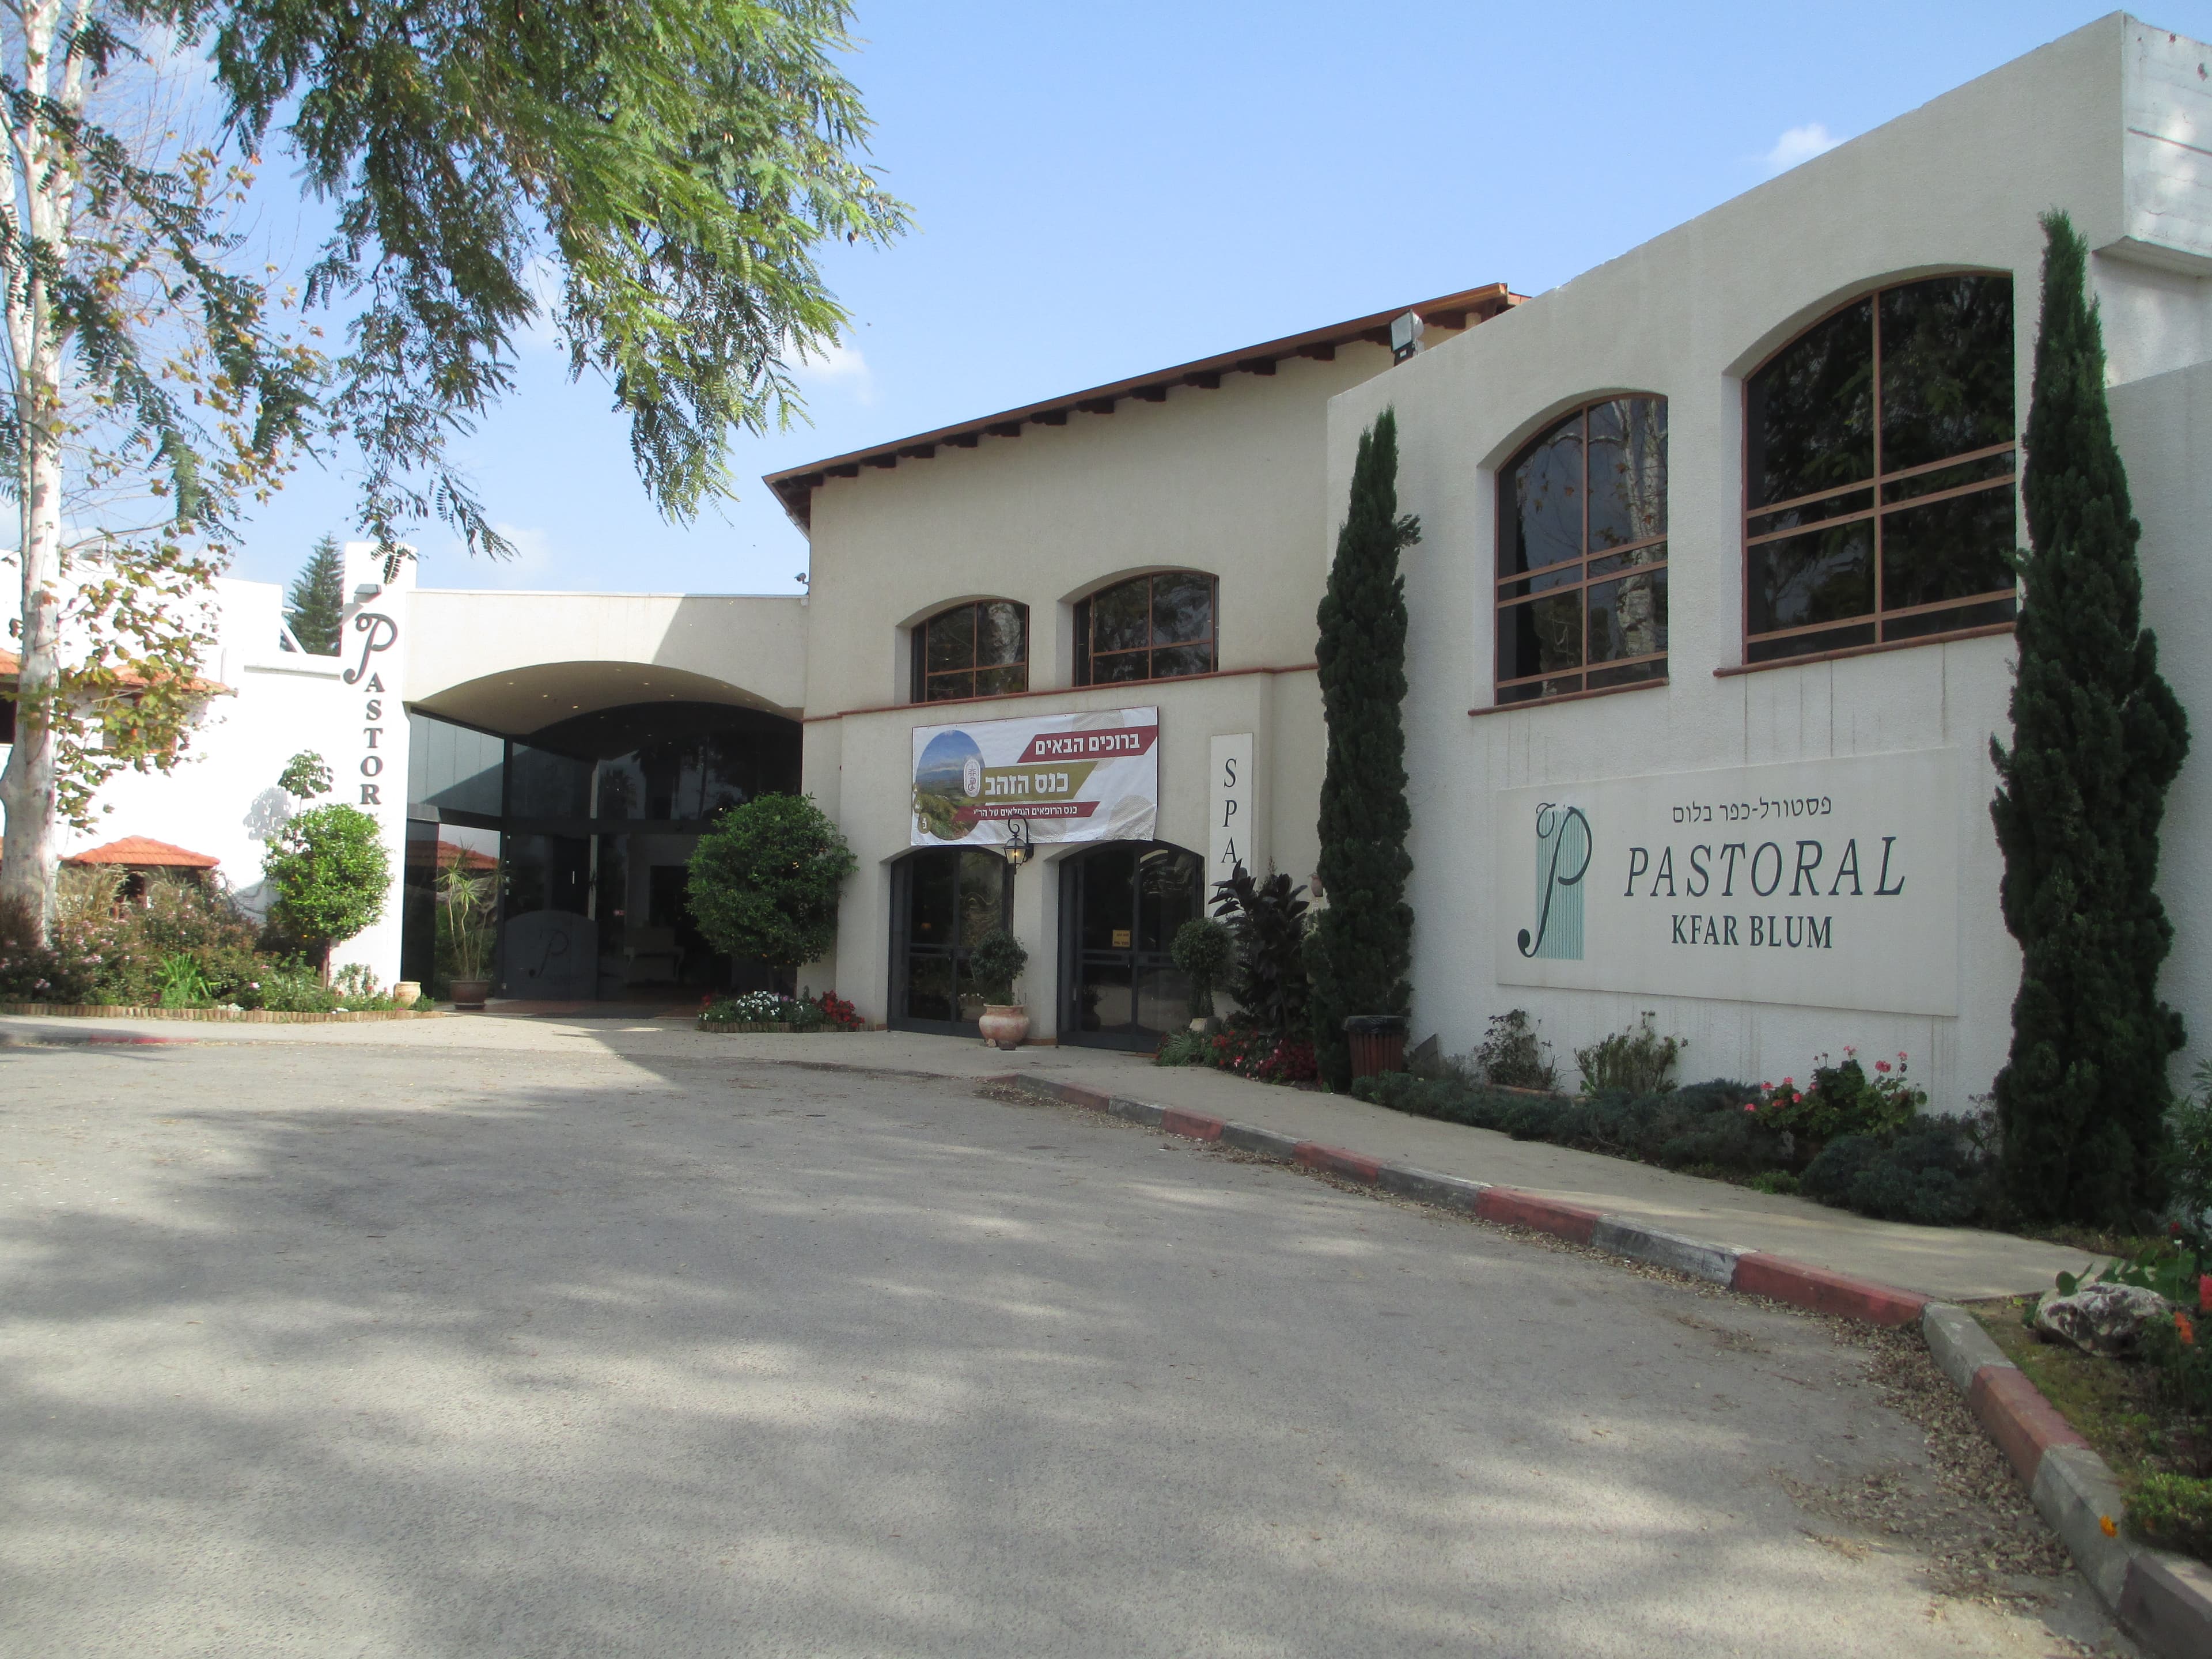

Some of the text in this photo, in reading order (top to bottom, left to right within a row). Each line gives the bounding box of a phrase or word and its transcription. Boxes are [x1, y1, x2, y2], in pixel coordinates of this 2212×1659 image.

[343, 612, 398, 805] PASTOR
[1035, 733, 1141, 756] ברוכים הבאים
[985, 774, 1029, 796] הזהב
[1035, 772, 1069, 794] כנס
[988, 807, 999, 817] של
[1000, 806, 1030, 817] הגמלאים
[1032, 806, 1062, 816] הרופאים
[1063, 805, 1078, 815] כנס
[1221, 757, 1238, 863] SPA
[1672, 796, 1832, 823] פסטורל-כפר בלום
[1623, 836, 1907, 897] PASTORAL
[1671, 914, 1832, 949] KFAR BLUM
